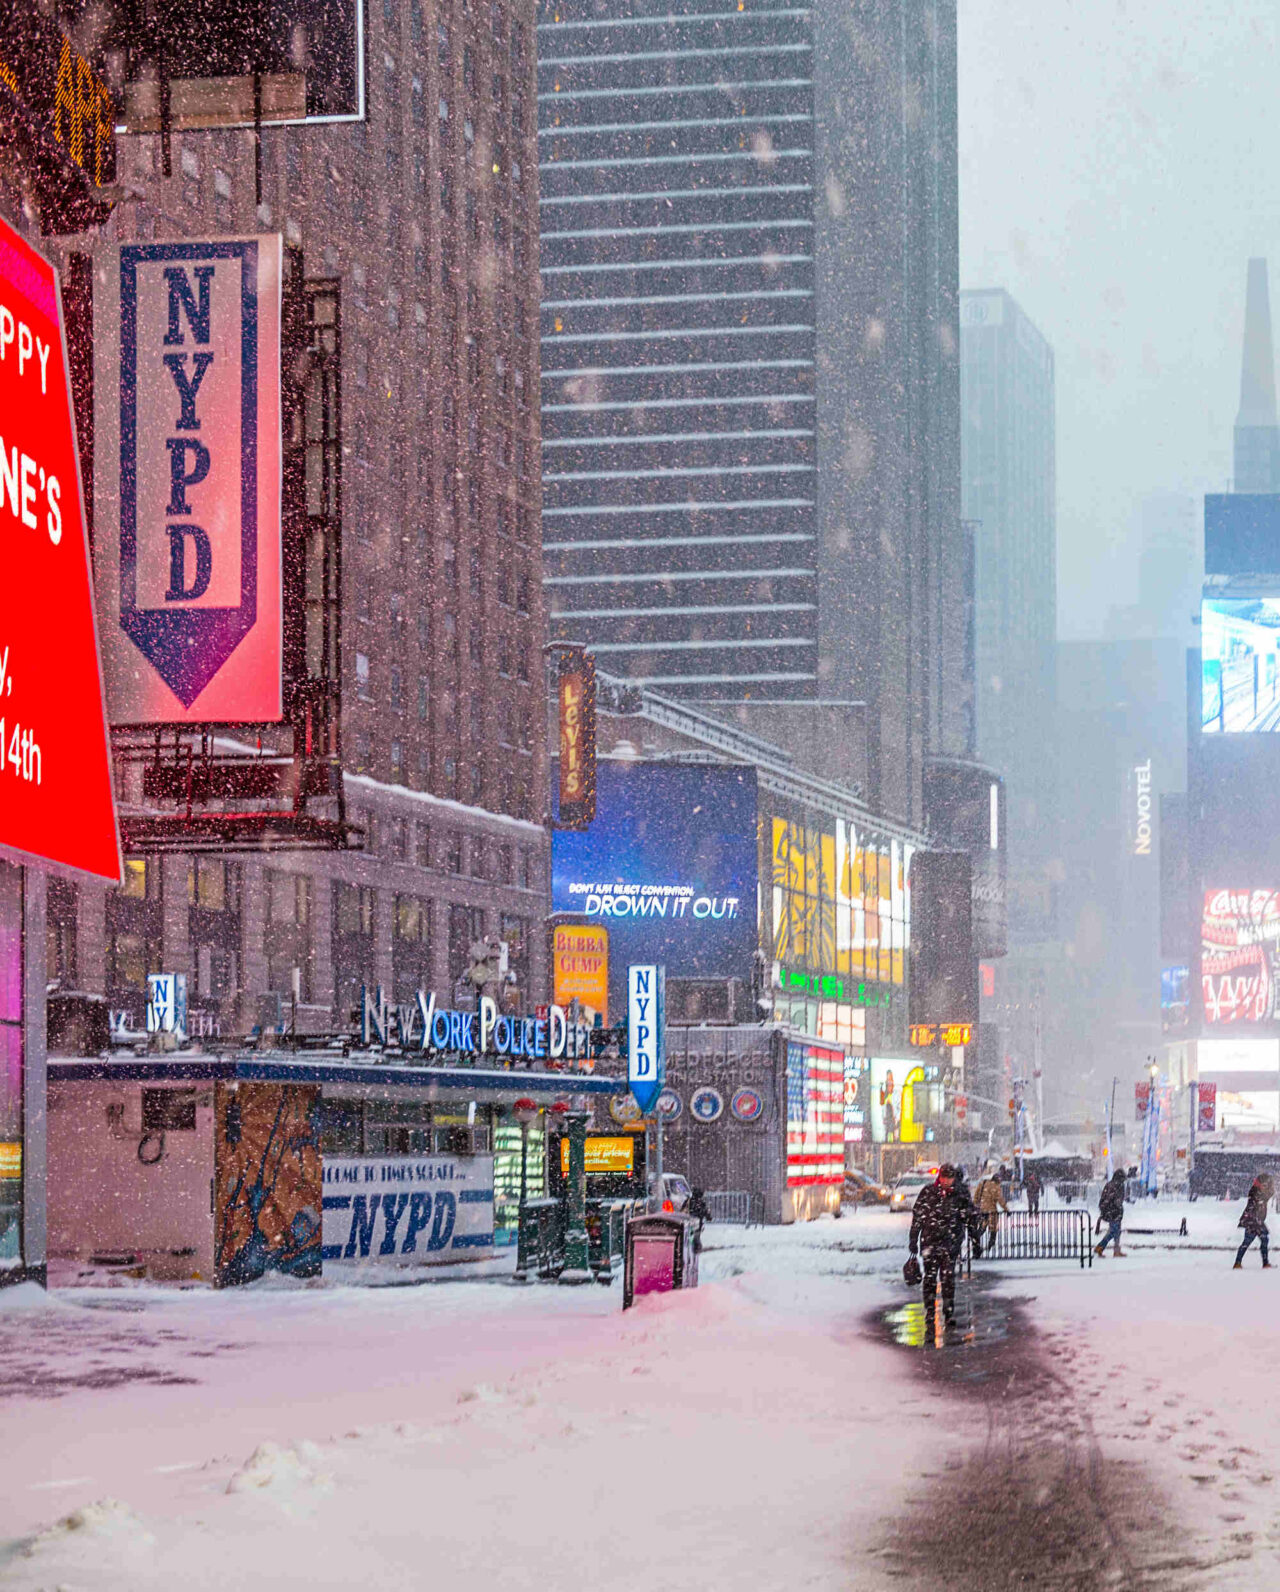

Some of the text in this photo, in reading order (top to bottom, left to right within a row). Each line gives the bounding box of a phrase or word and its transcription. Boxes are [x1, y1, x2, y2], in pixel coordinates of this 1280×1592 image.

[162, 265, 215, 602] NYPD
[1135, 758, 1151, 854] NOVOTEL
[585, 894, 669, 917] DROWN
[672, 896, 691, 918] IT
[557, 933, 604, 953] BUBBA
[560, 954, 602, 974] GUMP
[635, 969, 652, 1077] NYPD
[344, 1190, 457, 1258] NYPD
